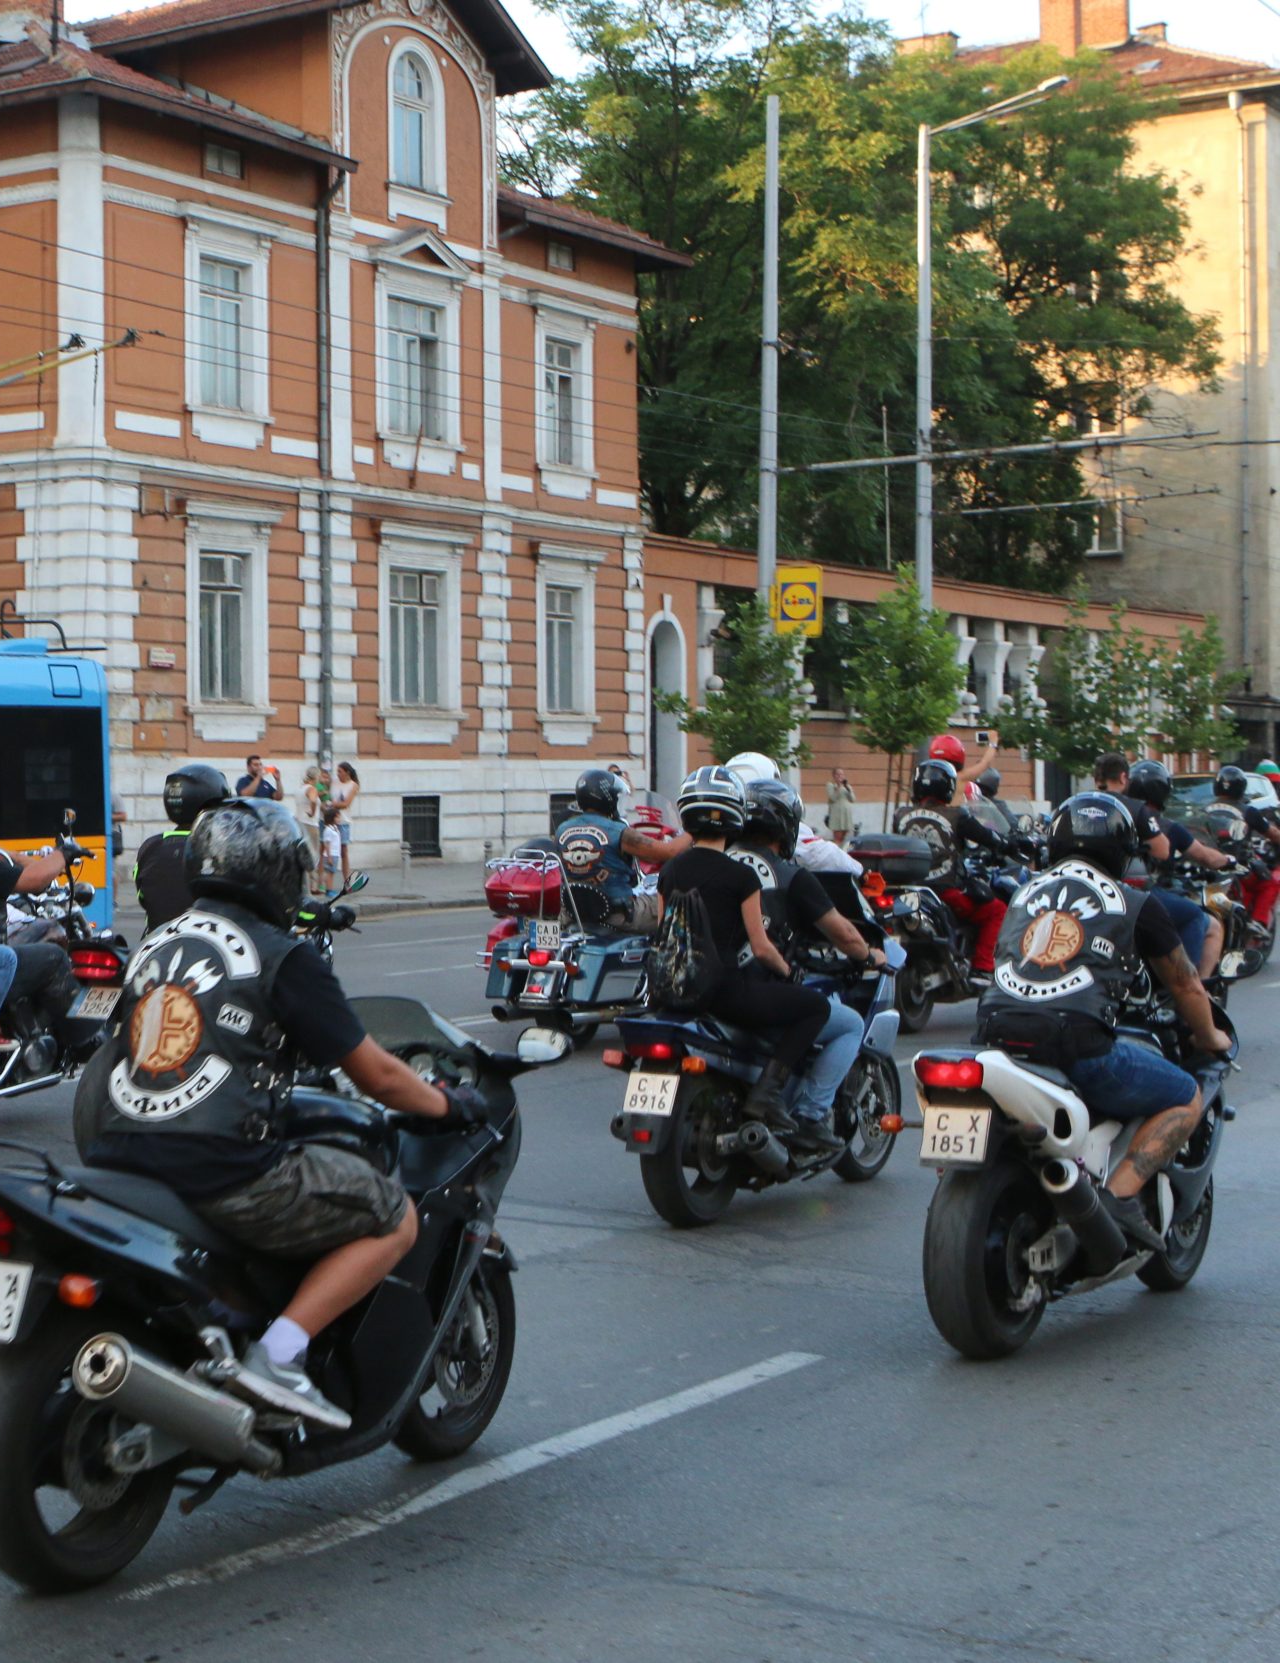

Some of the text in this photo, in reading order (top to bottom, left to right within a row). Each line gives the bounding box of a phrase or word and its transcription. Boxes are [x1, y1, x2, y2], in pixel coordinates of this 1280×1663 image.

[537, 924, 549, 935] CA
[87, 990, 104, 1001] CA
[638, 1078, 671, 1094] C K
[629, 1094, 666, 1110] 8916
[937, 1113, 981, 1133] C X
[931, 1134, 976, 1154] 1851
[5, 1273, 19, 1299] A
